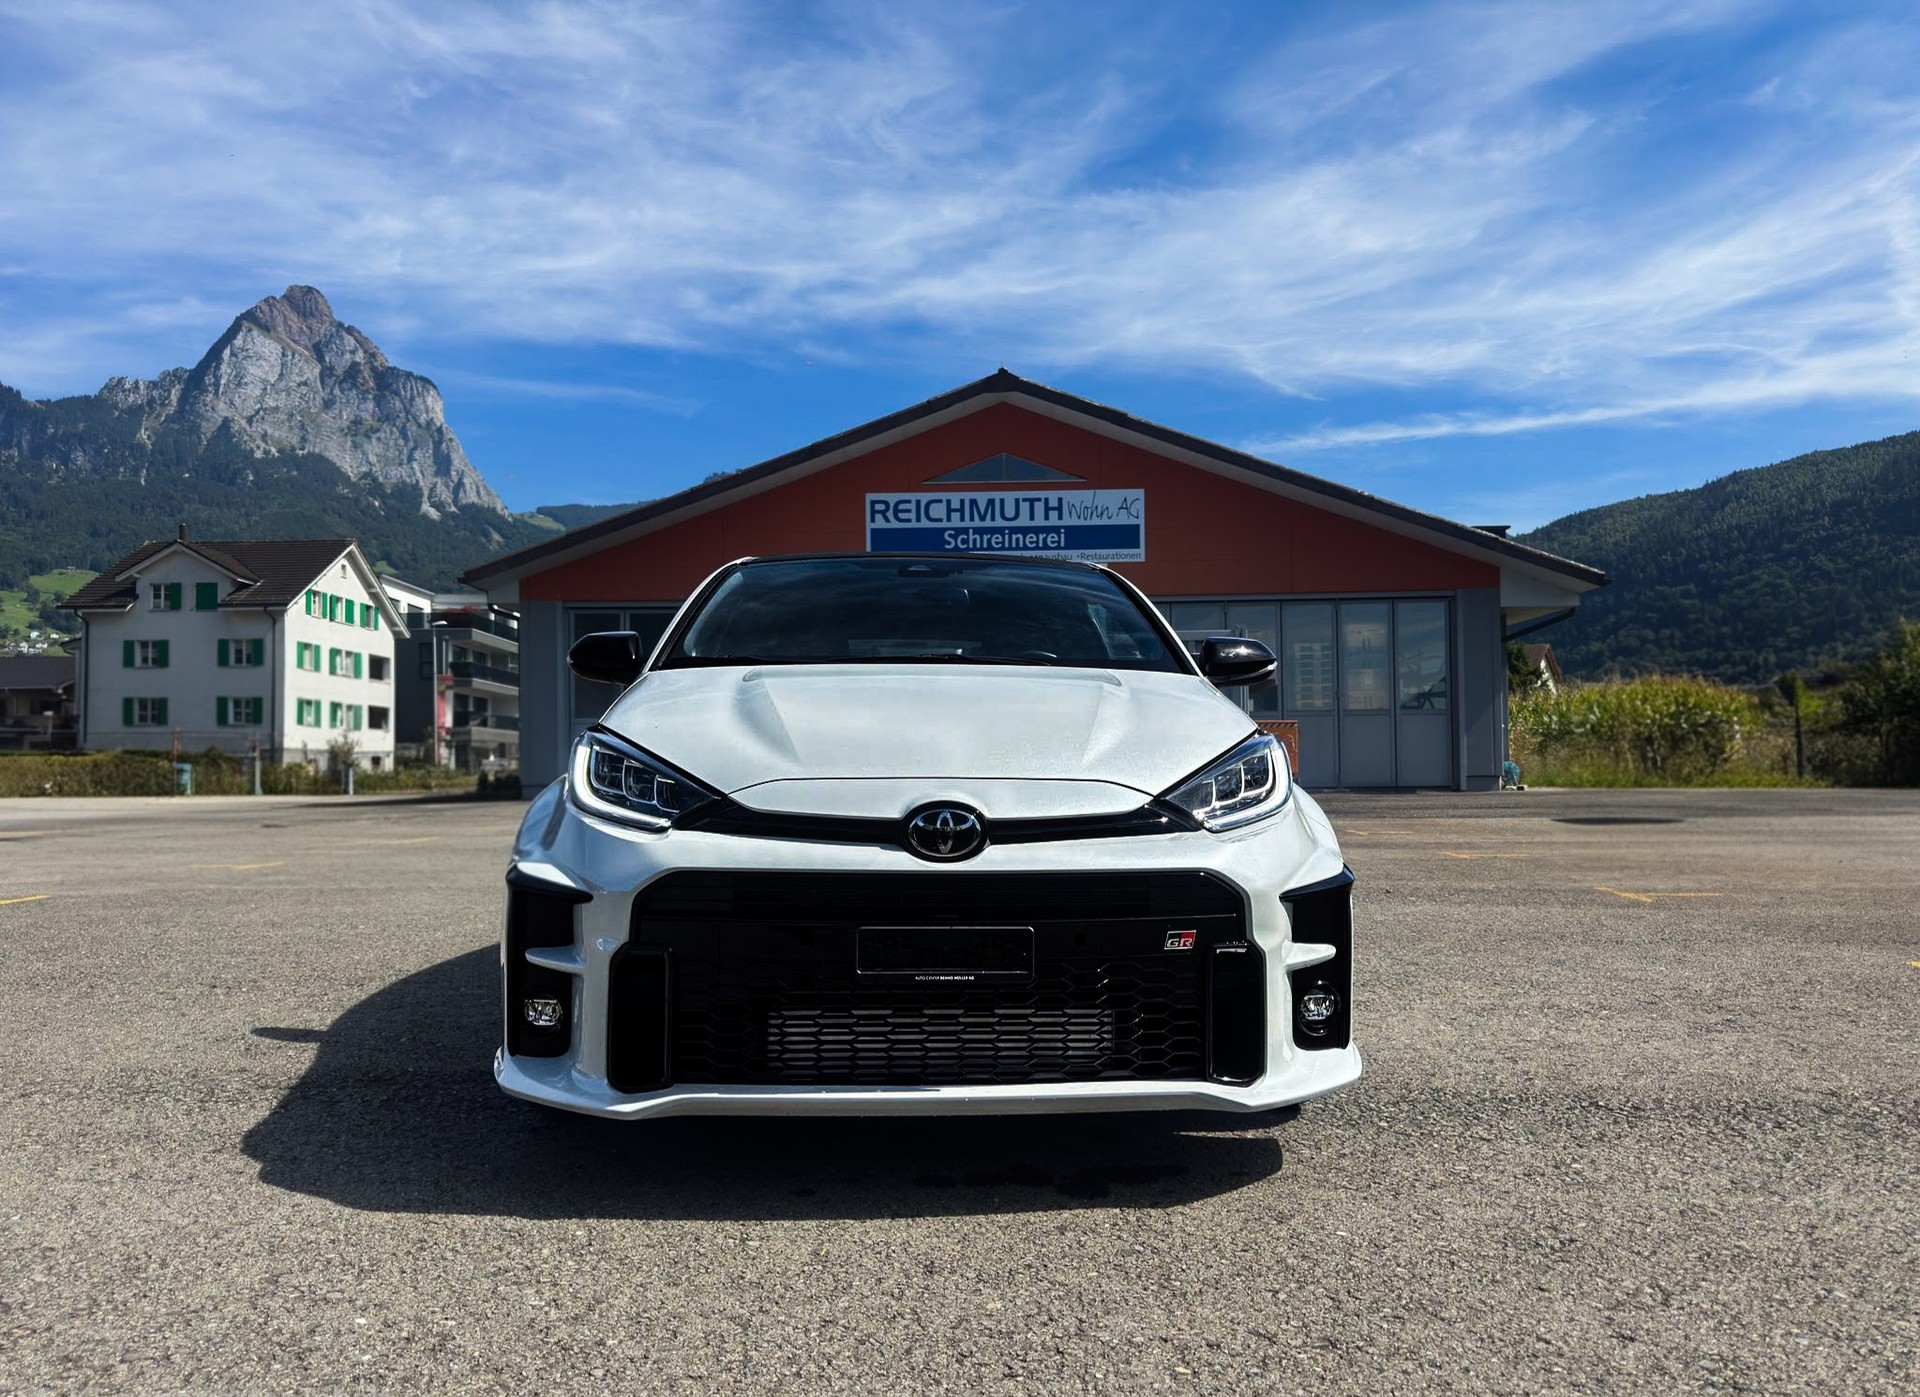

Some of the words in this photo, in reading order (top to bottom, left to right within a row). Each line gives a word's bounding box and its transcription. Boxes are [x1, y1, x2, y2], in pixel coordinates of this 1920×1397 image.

[870, 497, 1064, 524] REICHMUTH
[1067, 491, 1114, 521] Wohn
[1116, 496, 1141, 519] AG
[943, 529, 1066, 549] Schreinerei
[1166, 938, 1193, 948] GR
